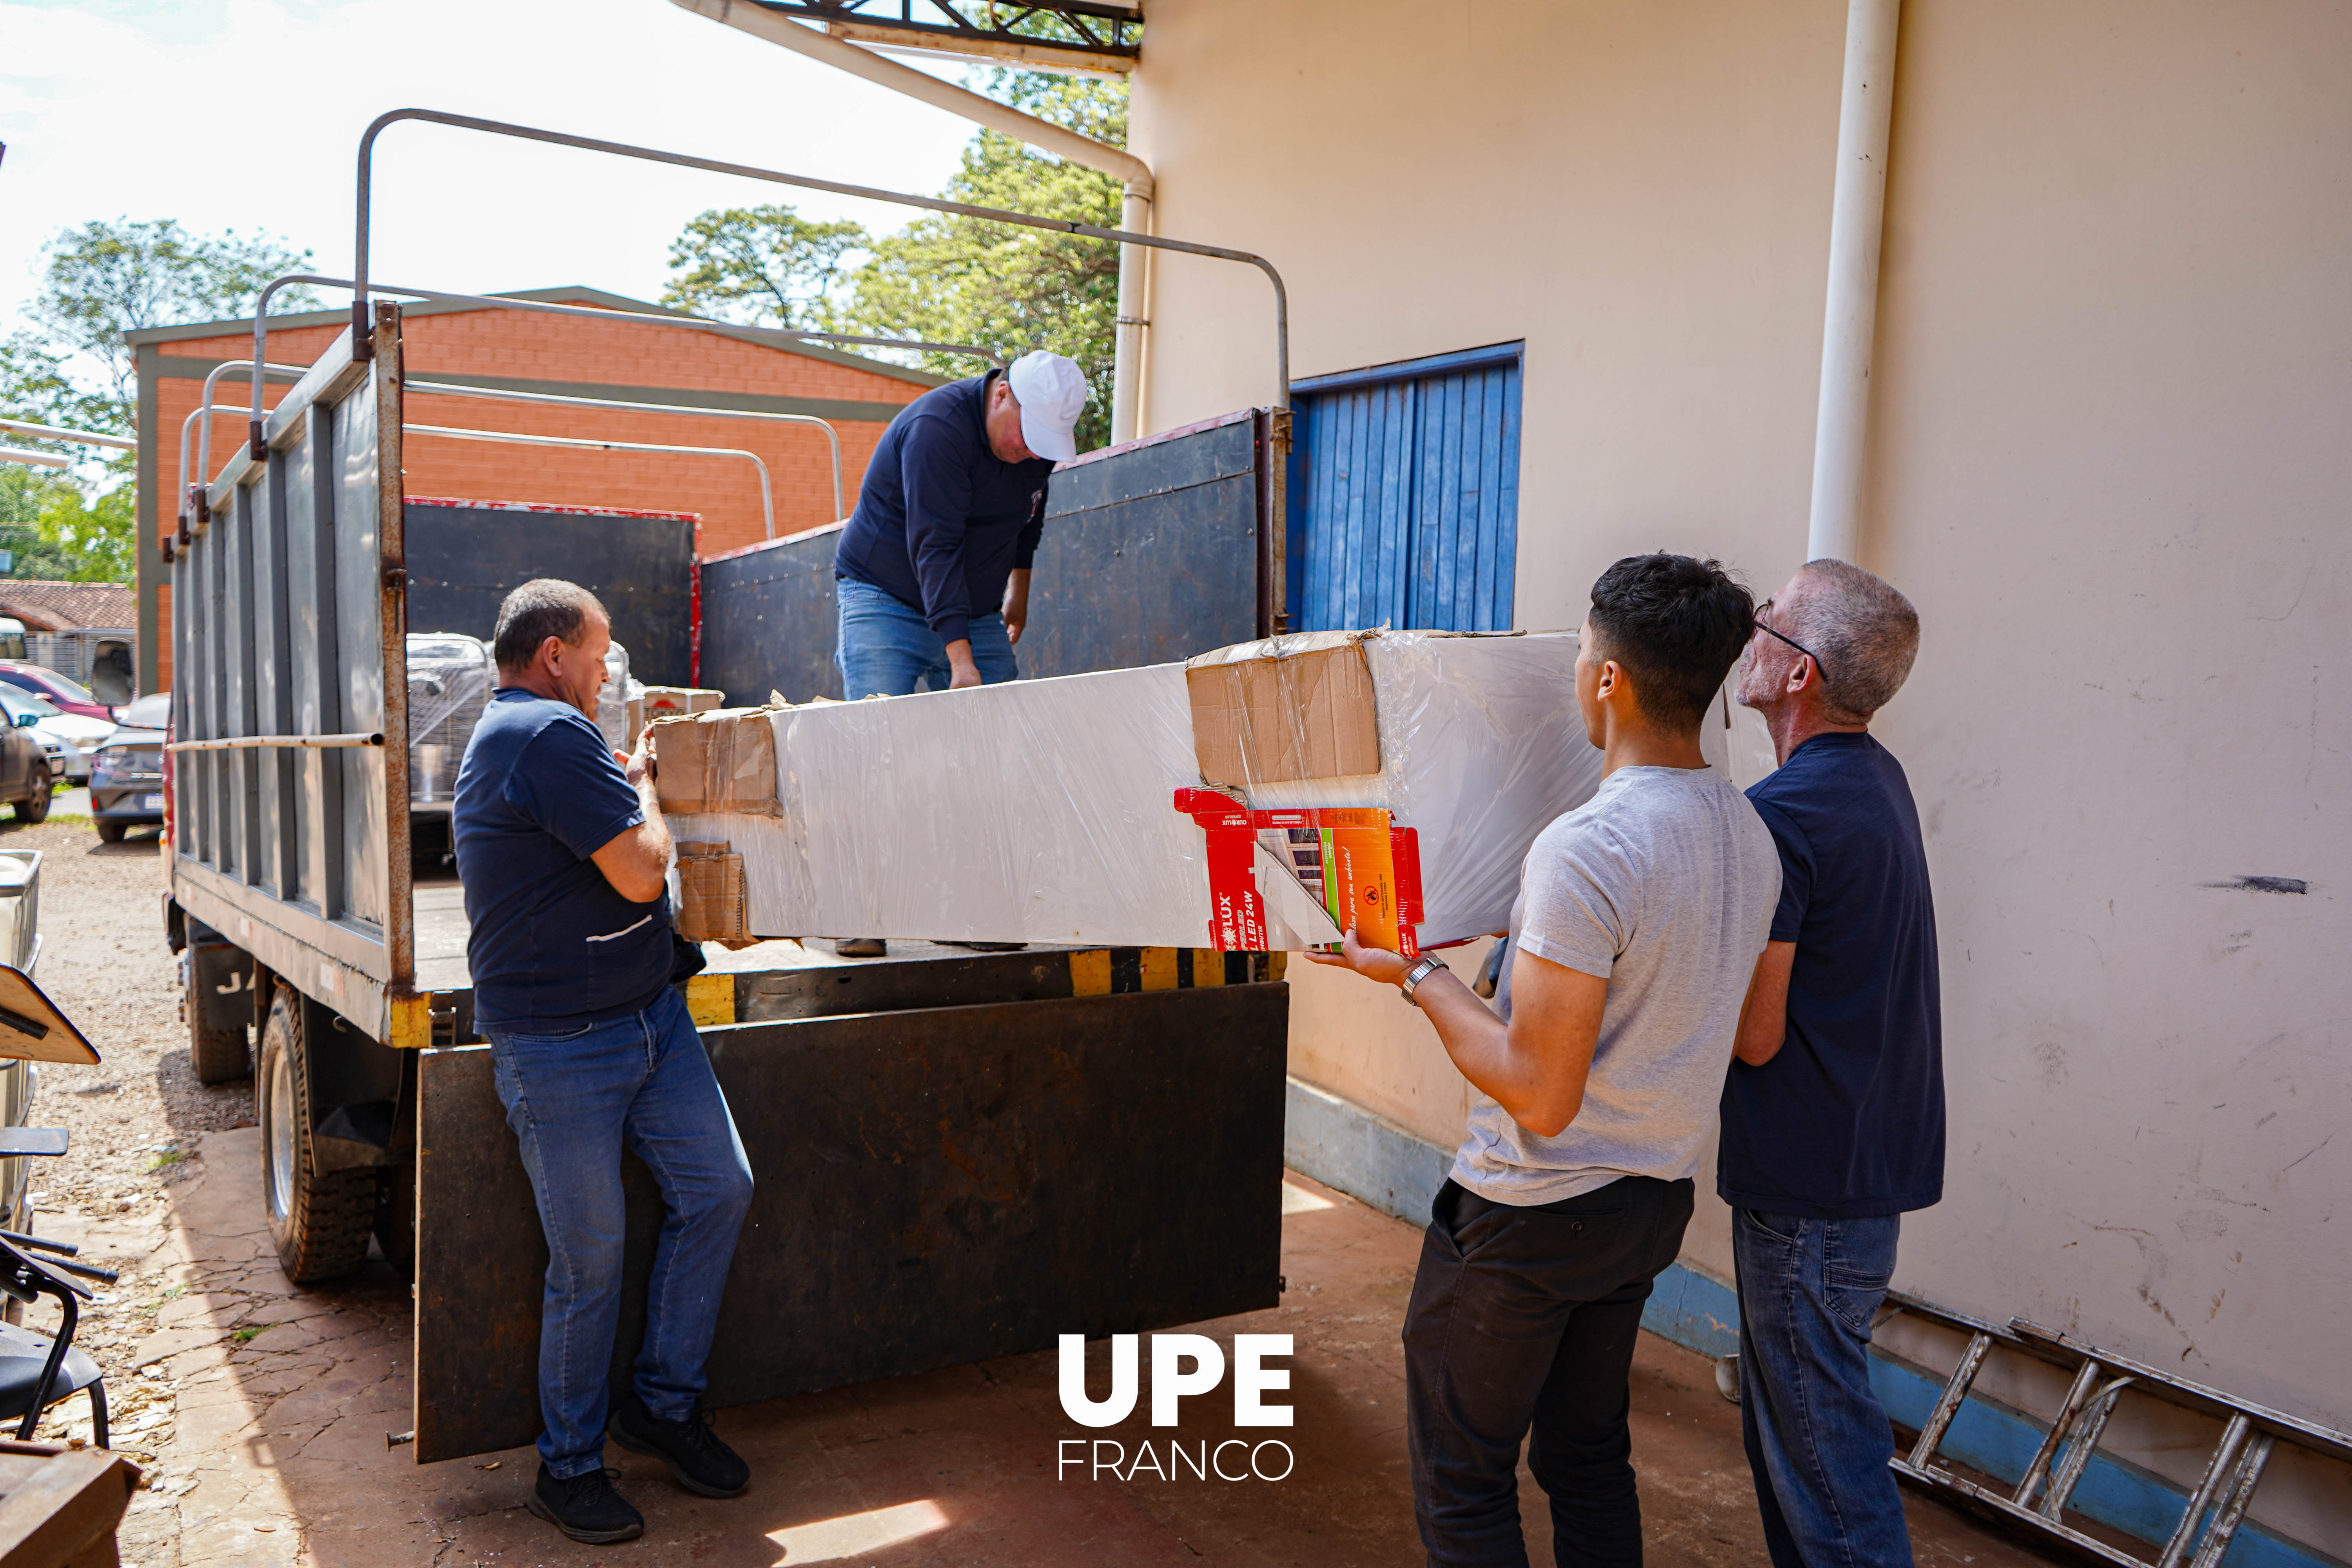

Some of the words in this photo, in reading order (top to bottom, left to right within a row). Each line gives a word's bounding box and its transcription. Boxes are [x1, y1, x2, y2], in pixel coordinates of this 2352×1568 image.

[644, 708, 684, 717] TOKYO
[1342, 846, 1353, 881] ambiente!
[1244, 890, 1254, 917] 24W
[1350, 897, 1358, 915] para
[1247, 919, 1257, 942] LED
